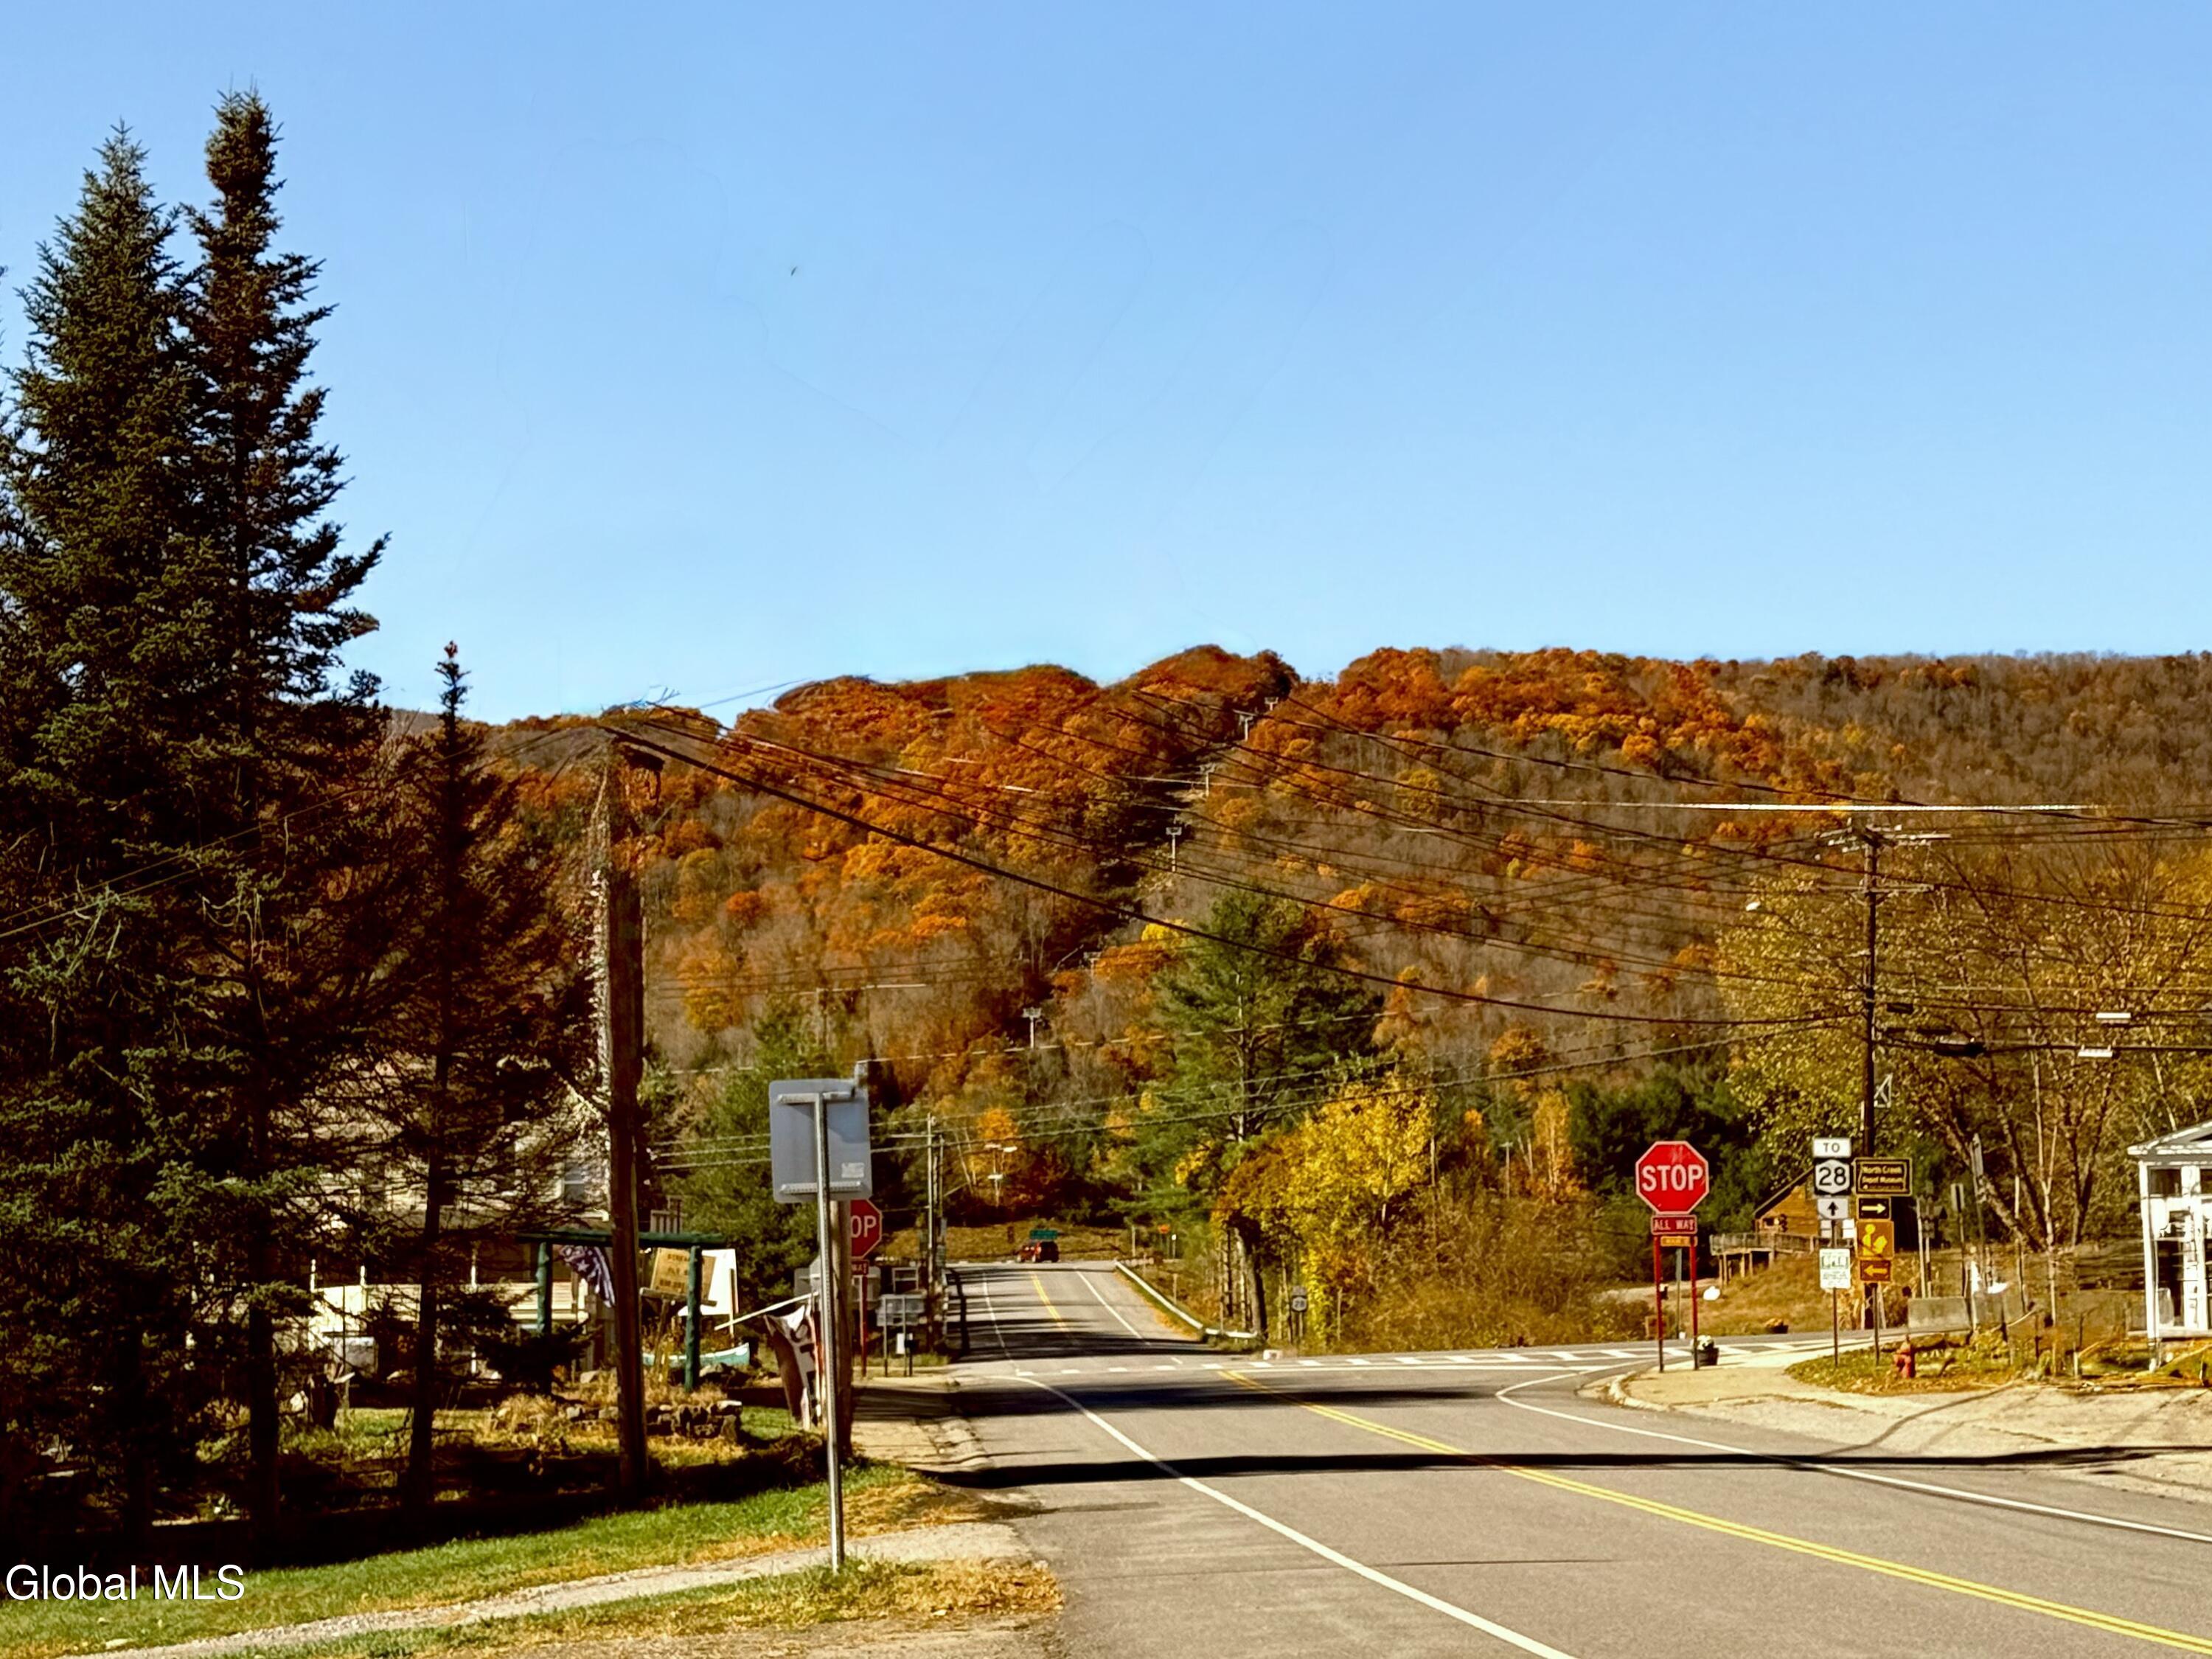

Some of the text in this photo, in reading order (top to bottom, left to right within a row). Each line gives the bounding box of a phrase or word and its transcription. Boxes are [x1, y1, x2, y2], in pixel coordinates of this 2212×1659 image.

[1823, 1142, 1840, 1153] TO
[1641, 1164, 1704, 1192] STOP
[1818, 1166, 1847, 1186] 28
[850, 1215, 877, 1238] OP
[1654, 1219, 1694, 1231] ALL WAY
